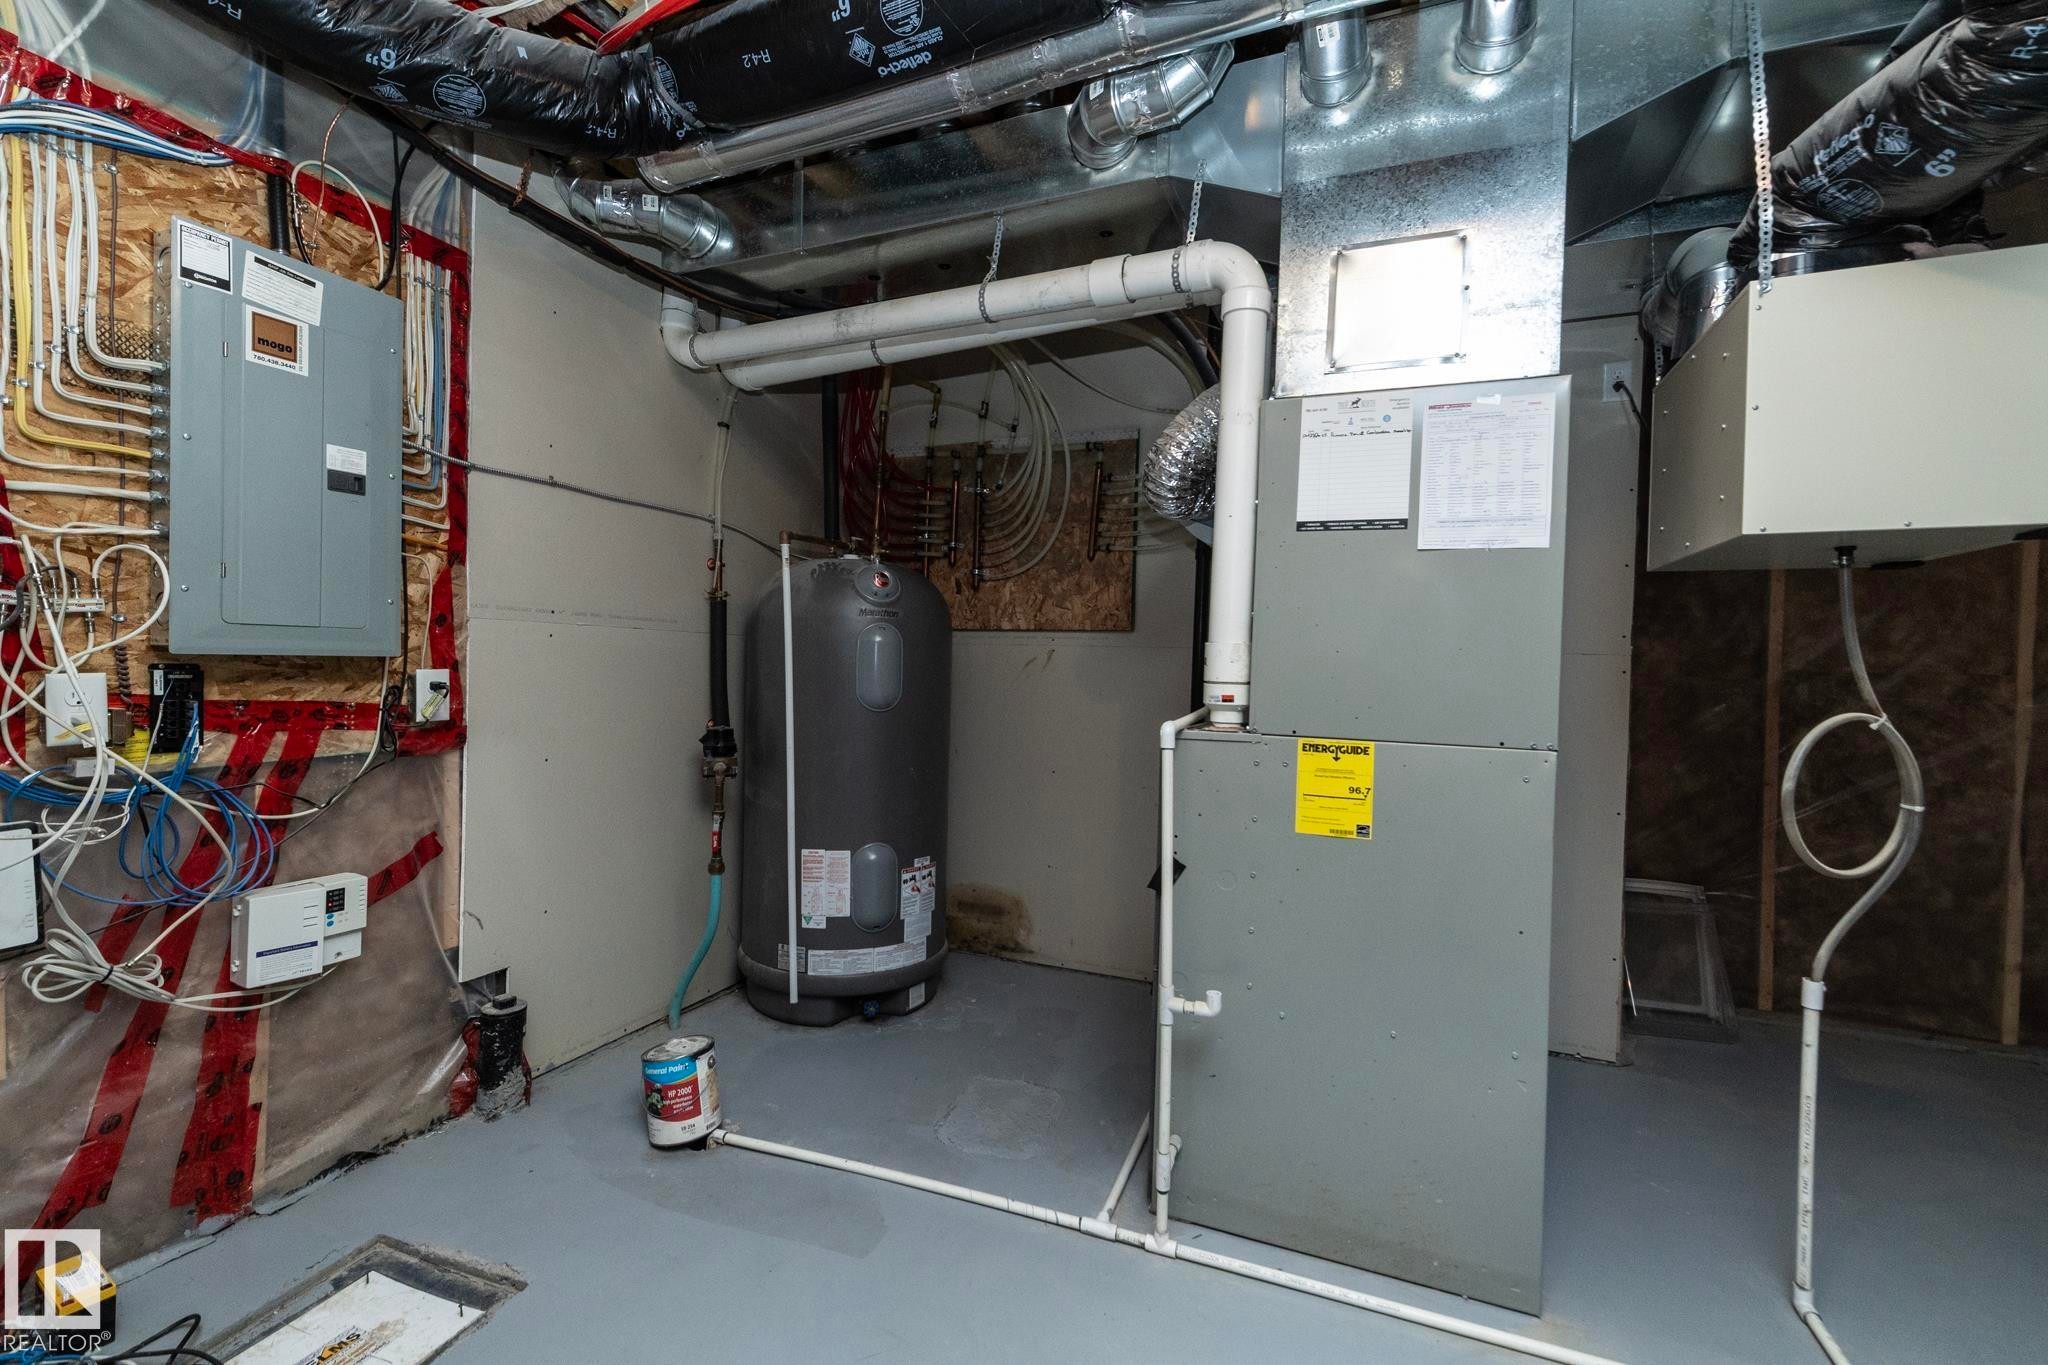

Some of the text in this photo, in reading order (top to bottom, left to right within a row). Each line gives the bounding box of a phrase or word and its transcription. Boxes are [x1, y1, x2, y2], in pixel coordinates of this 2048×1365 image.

[365, 48, 397, 70] 6"
[741, 49, 772, 69] R-4.2
[1924, 148, 1957, 178] 6"
[257, 337, 293, 353] mogo
[858, 607, 899, 618] Marathon
[1302, 742, 1370, 757] ENERGYGUIDE
[1348, 786, 1371, 796] 96.7
[667, 1090, 677, 1098] HP
